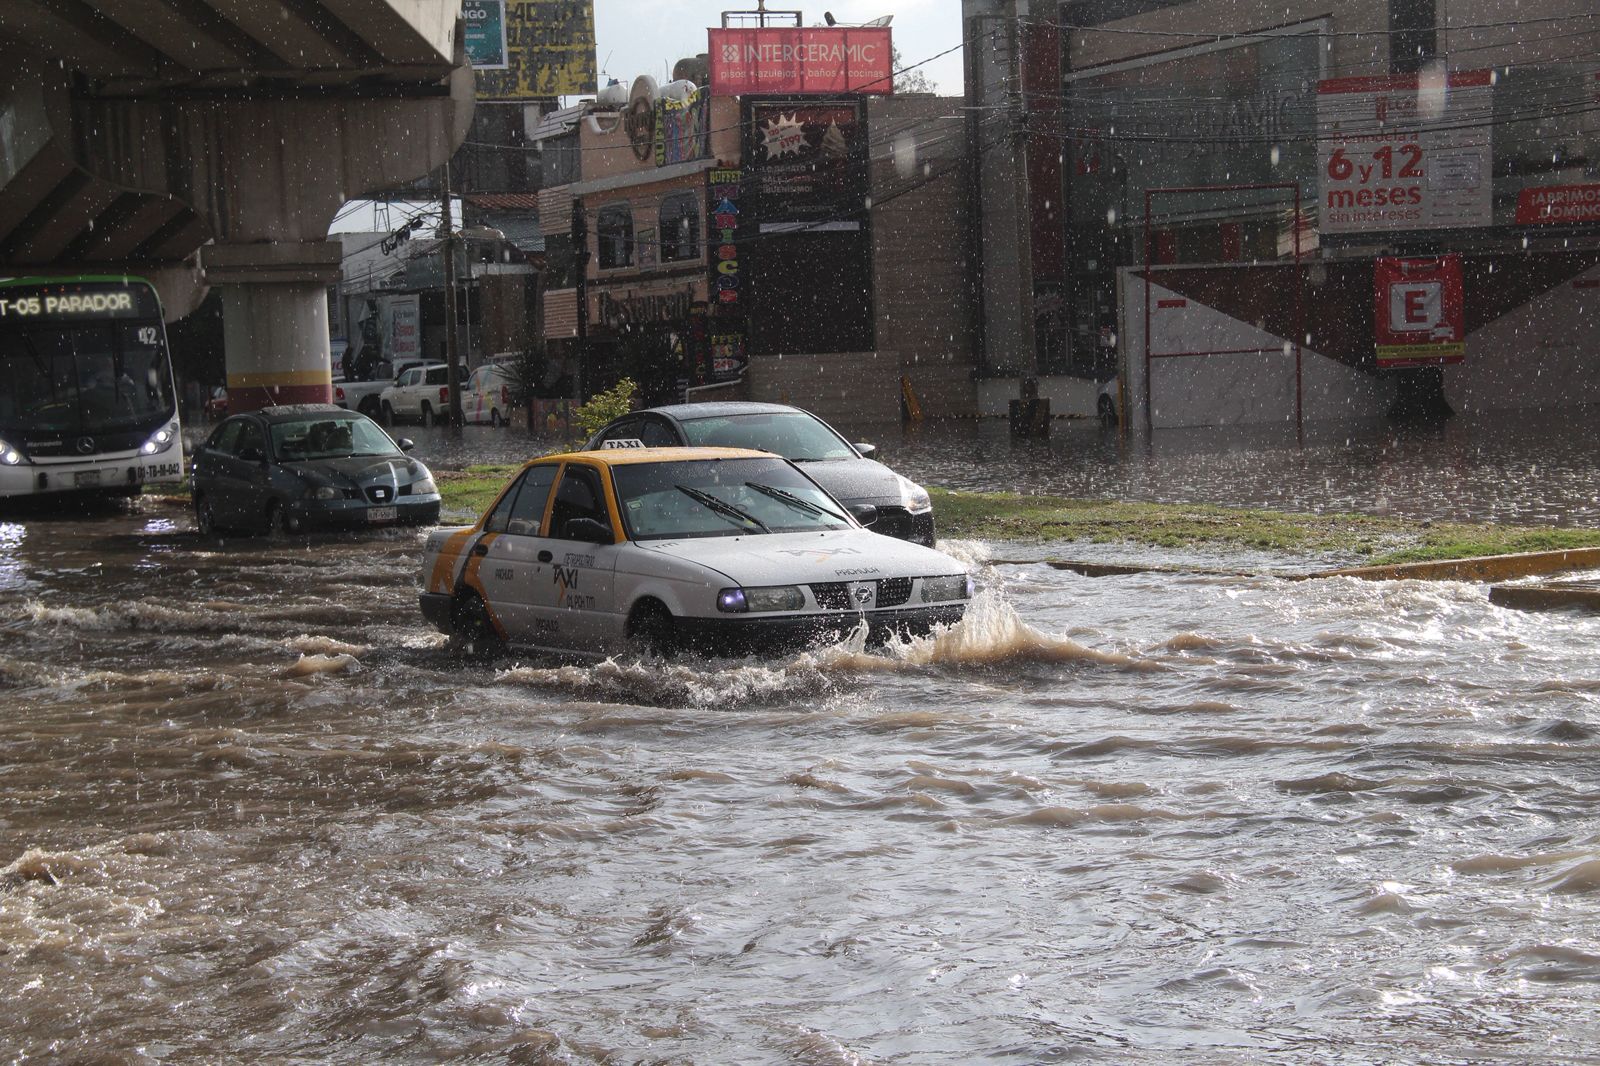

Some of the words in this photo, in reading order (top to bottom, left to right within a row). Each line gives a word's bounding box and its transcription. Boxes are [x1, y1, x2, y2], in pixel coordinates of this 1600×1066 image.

[744, 44, 877, 63] INTERCERAMIC
[721, 70, 746, 82] pisos
[758, 68, 797, 81] azulejos
[808, 67, 837, 80] baños
[848, 69, 884, 80] cocinas
[1328, 148, 1354, 181] 6
[1359, 164, 1374, 184] y
[1373, 144, 1424, 180] 12
[1328, 186, 1422, 209] meses
[1328, 211, 1350, 223] sin
[0, 298, 40, 315] T-05
[46, 293, 131, 313] PARADOR
[1405, 290, 1428, 323] E
[138, 328, 157, 344] 42
[606, 441, 641, 450] TAXI
[553, 564, 579, 590] TAXI
